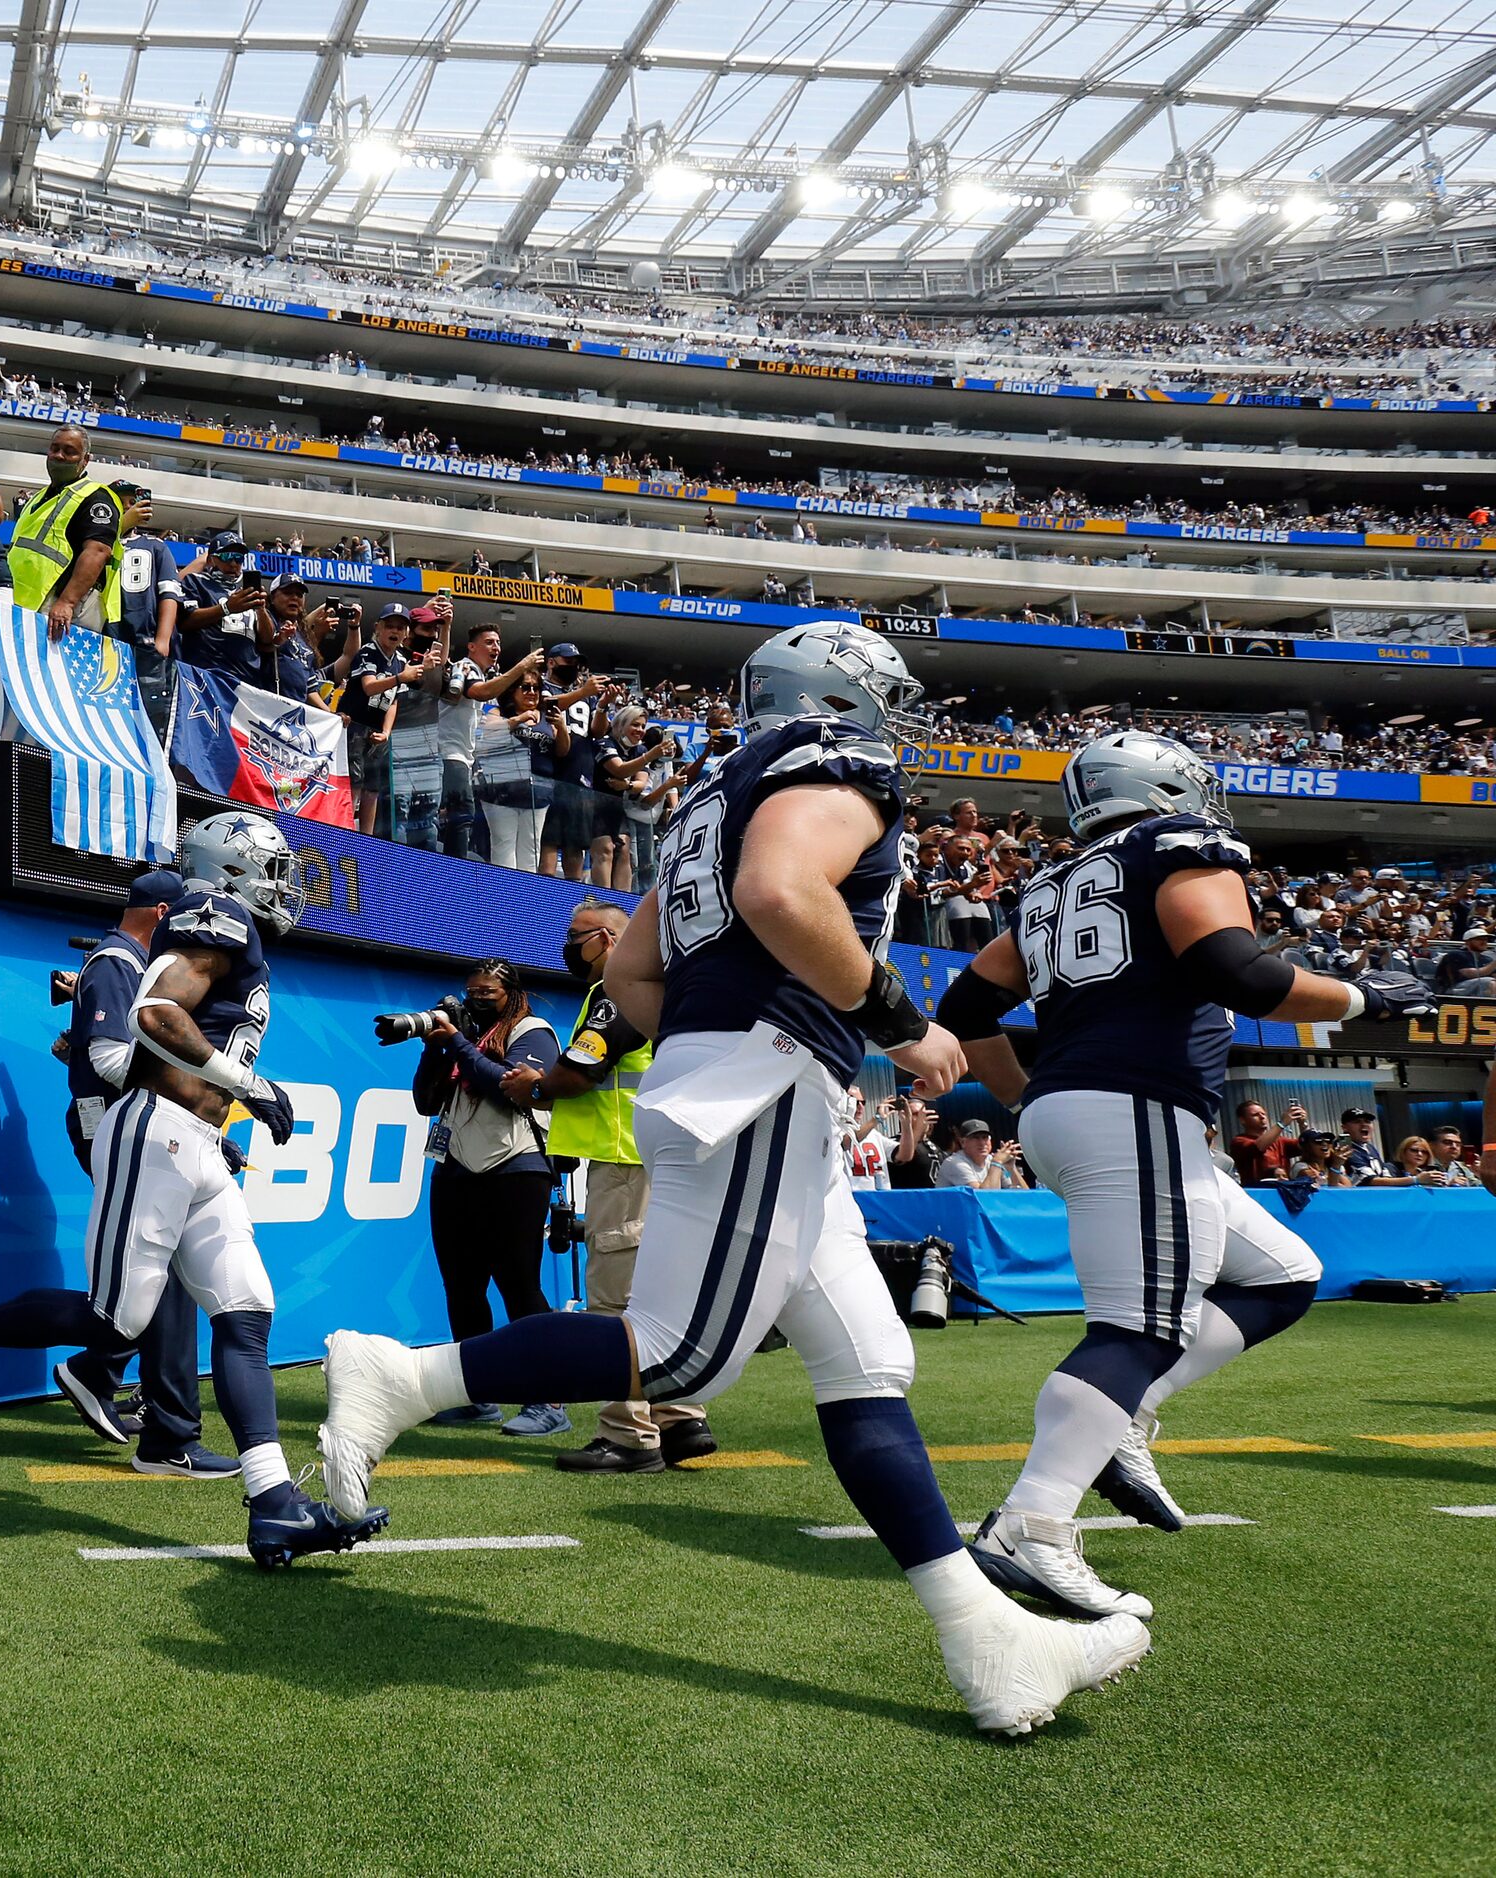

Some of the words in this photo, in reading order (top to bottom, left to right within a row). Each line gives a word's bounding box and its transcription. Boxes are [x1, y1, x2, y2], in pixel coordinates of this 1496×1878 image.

[23, 262, 115, 287] CHARGERS
[212, 292, 286, 313] #BOLTUP
[361, 313, 391, 328] LOS
[395, 318, 466, 337] ANGELES
[467, 327, 549, 347] CHARGERS
[619, 347, 687, 363] #BOLTUP
[758, 360, 785, 373] LOS
[790, 363, 856, 379] ANGELES
[857, 370, 934, 386] CHARGERS
[223, 432, 273, 449] BOLT
[274, 438, 301, 452] UP
[400, 453, 521, 482] CHARGERS
[638, 481, 684, 497] BOLT
[684, 485, 708, 499] UP
[795, 496, 908, 518] CHARGERS
[1018, 515, 1060, 528] BOLT
[1060, 518, 1086, 530] UP
[1180, 525, 1289, 544] CHARGERS
[1416, 536, 1459, 549] BOLT
[1460, 538, 1482, 550] UP
[260, 554, 294, 573] SUITE
[299, 558, 322, 578] FOR
[326, 562, 336, 579] A
[338, 563, 373, 584] GAME
[454, 574, 584, 607] CHARGERSSUITES.COM
[659, 598, 741, 617] #BOLTUP
[865, 619, 881, 629] Q1
[884, 618, 931, 634] 10:43
[1187, 636, 1196, 653] 0
[1224, 637, 1233, 655] 0
[1377, 648, 1408, 659] BALL
[1410, 650, 1430, 660] ON
[981, 753, 1022, 775] UP
[1018, 852, 1132, 1003] 66
[774, 1038, 792, 1054] NFL
